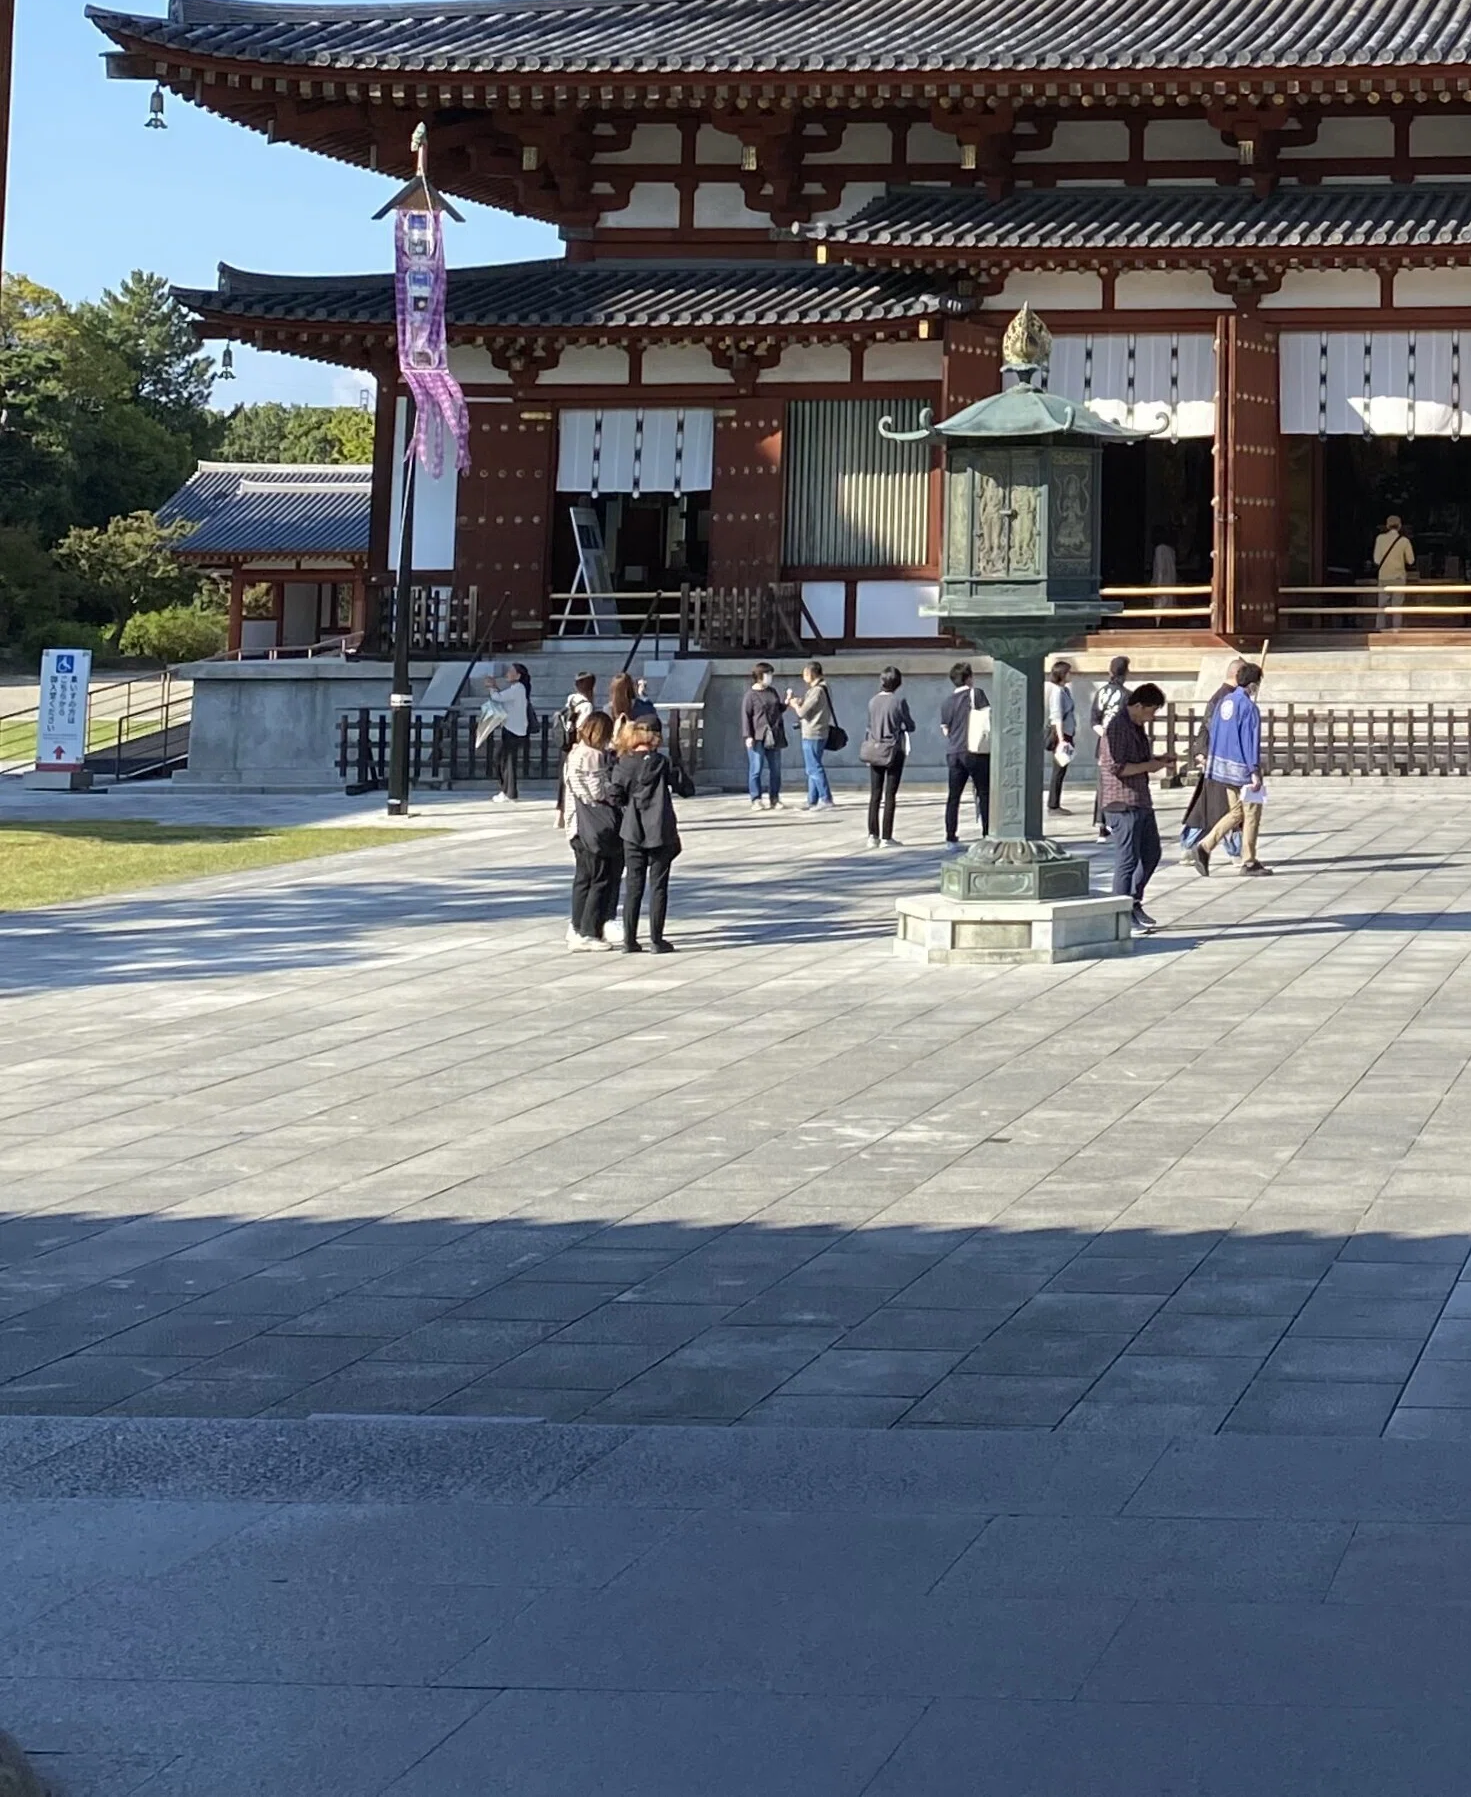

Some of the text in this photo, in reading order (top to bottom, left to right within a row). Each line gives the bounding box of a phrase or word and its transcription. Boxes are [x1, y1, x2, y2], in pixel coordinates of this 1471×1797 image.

[58, 675, 68, 716] こちらから
[67, 676, 78, 724] 車いすの方は
